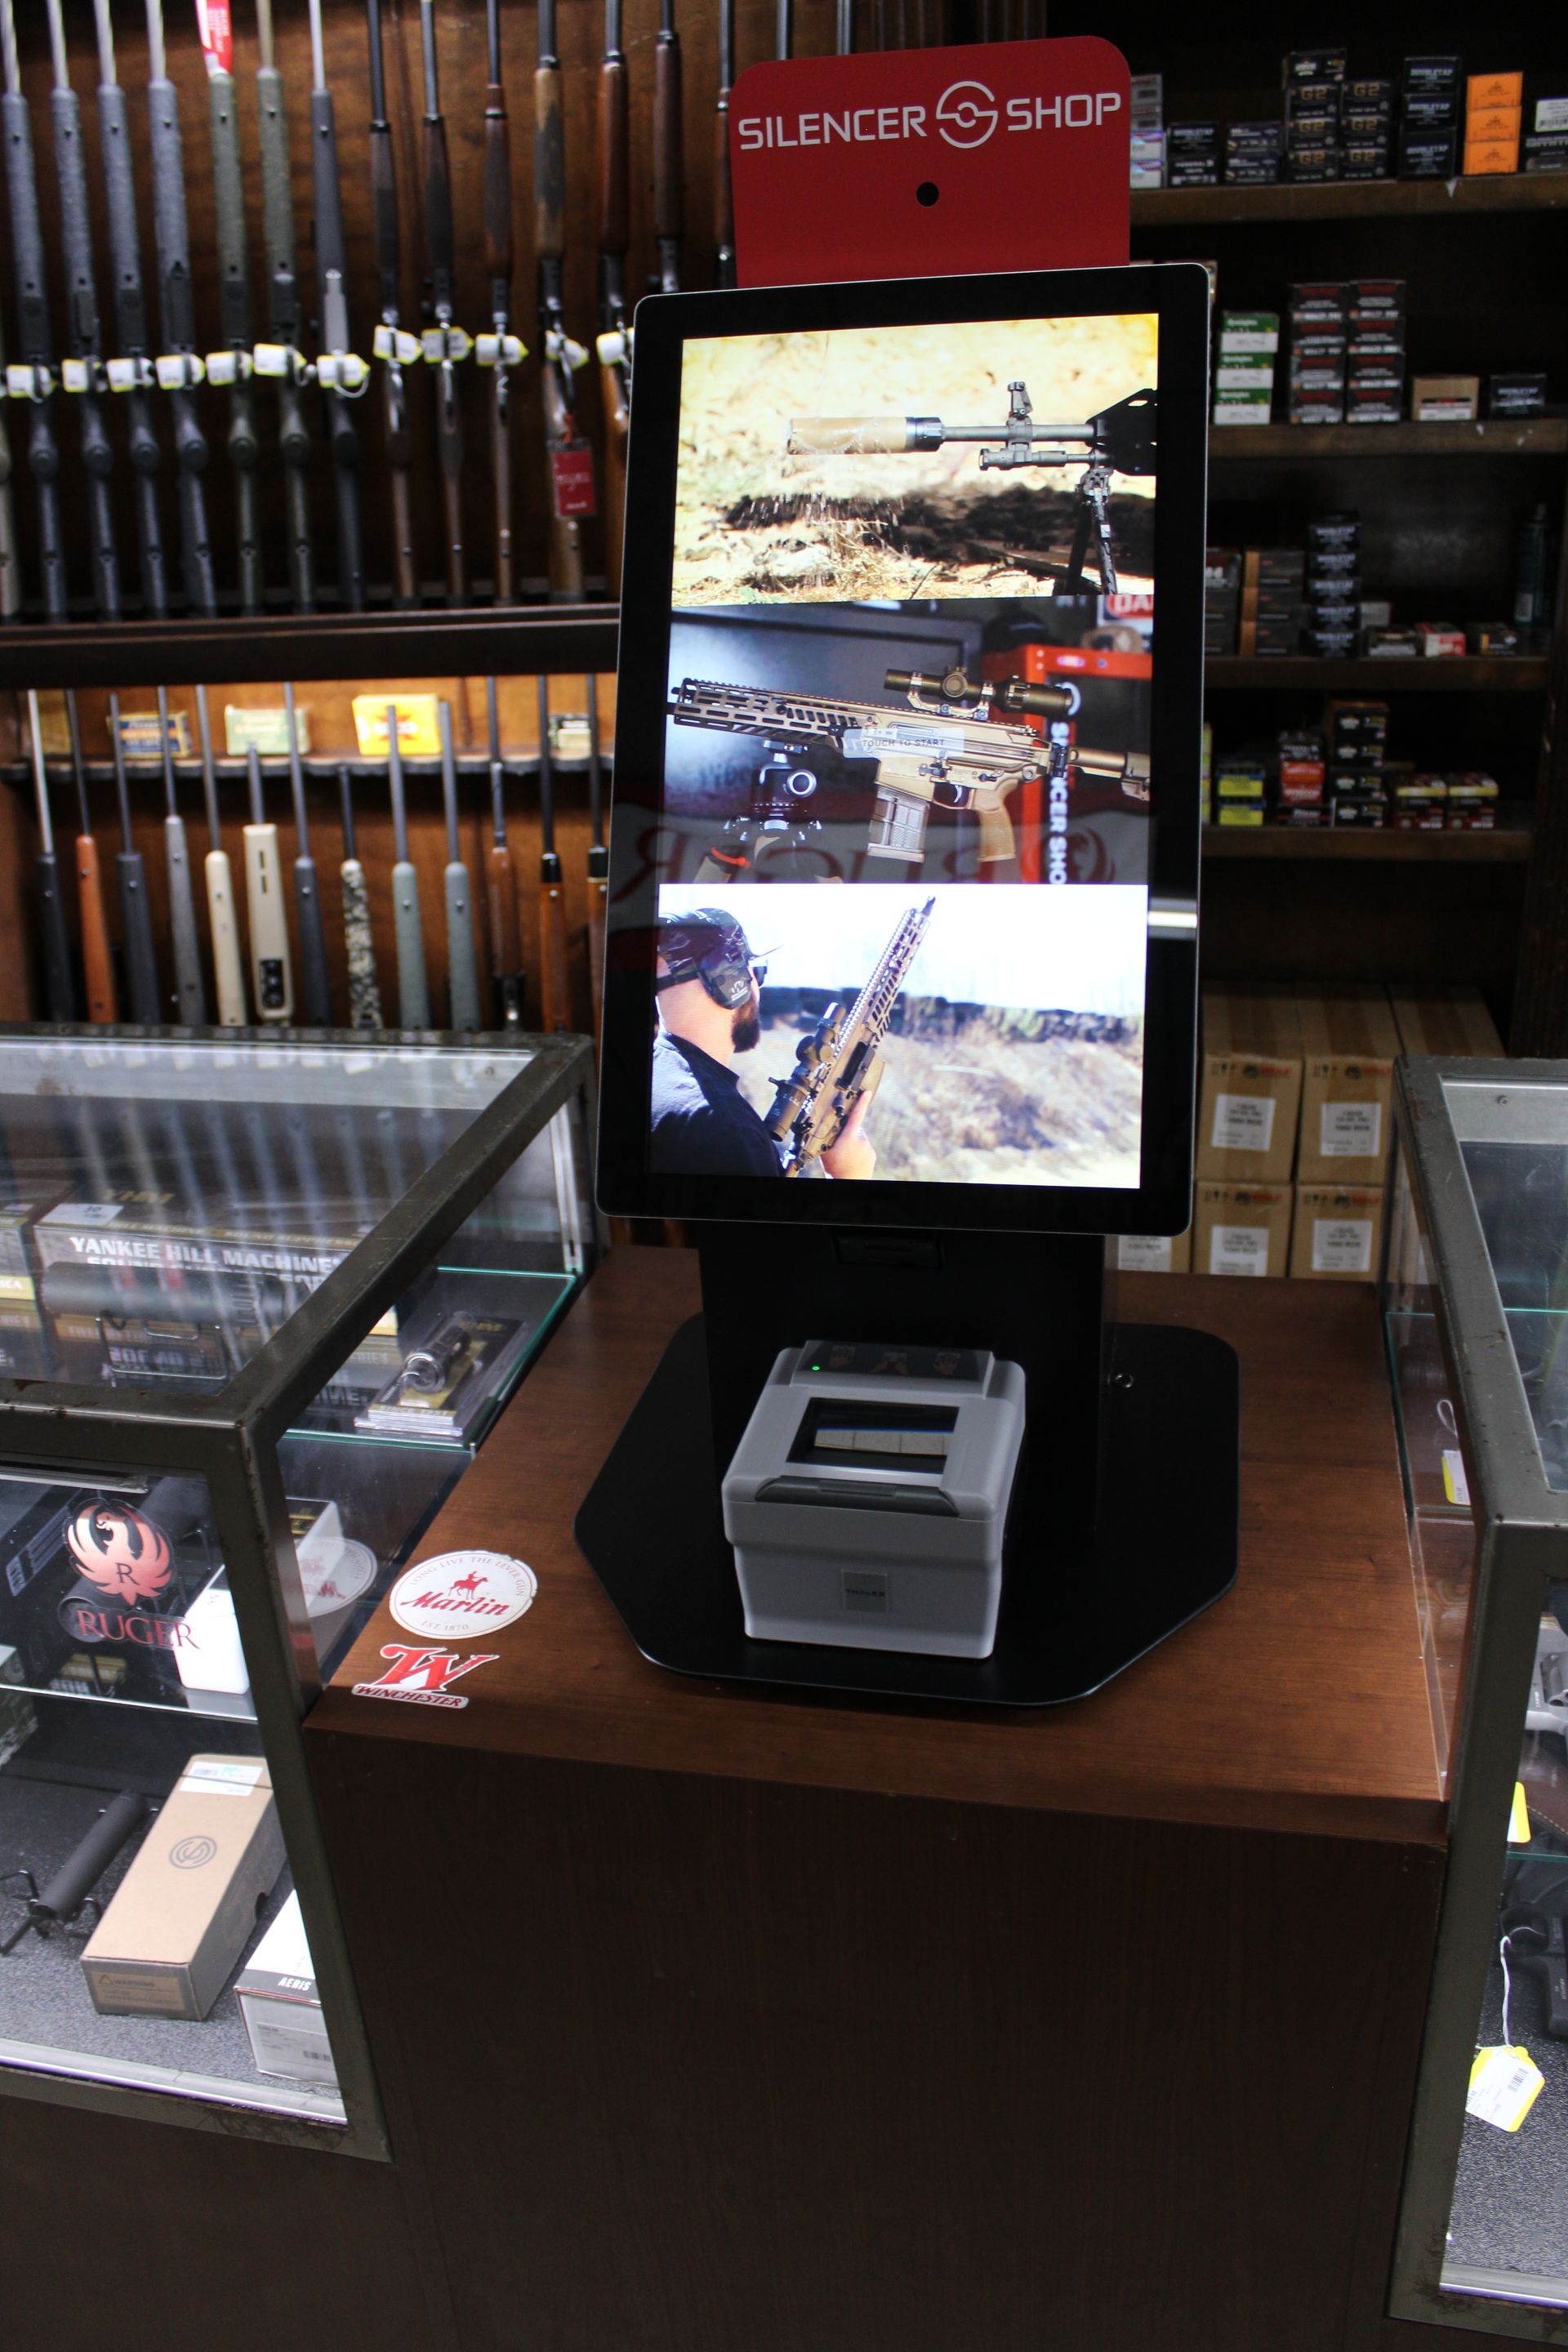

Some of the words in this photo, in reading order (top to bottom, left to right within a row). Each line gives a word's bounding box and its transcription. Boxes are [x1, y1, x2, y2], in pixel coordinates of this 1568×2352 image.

[1300, 86, 1329, 100] G2
[1353, 82, 1381, 96] G2
[738, 105, 928, 150] SILENCER
[1006, 92, 1121, 132] SHOP
[1298, 119, 1326, 132] G2
[1351, 118, 1379, 131] G2
[1298, 151, 1326, 165] G2
[1349, 150, 1377, 163] G2
[1114, 595, 1153, 613] DA
[862, 738, 895, 747] TOUCH
[899, 738, 911, 746] TO
[914, 737, 946, 746] START
[69, 1236, 161, 1260] YANKEE
[166, 1242, 218, 1265] HILL
[222, 1249, 334, 1276] MACHINE
[114, 1562, 140, 1584] R
[408, 1566, 438, 1587] LONG
[440, 1557, 466, 1569] LIVE
[470, 1556, 494, 1566] THE
[494, 1560, 521, 1579] LEVER
[514, 1579, 528, 1597] GUN
[844, 1588, 886, 1597] THALES
[399, 1591, 510, 1617] Marlin
[75, 1609, 202, 1650] RUGER
[421, 1619, 441, 1631] EST
[444, 1624, 470, 1632] 1870
[381, 1644, 499, 1691] W
[357, 1685, 462, 1708] WINCHESTER
